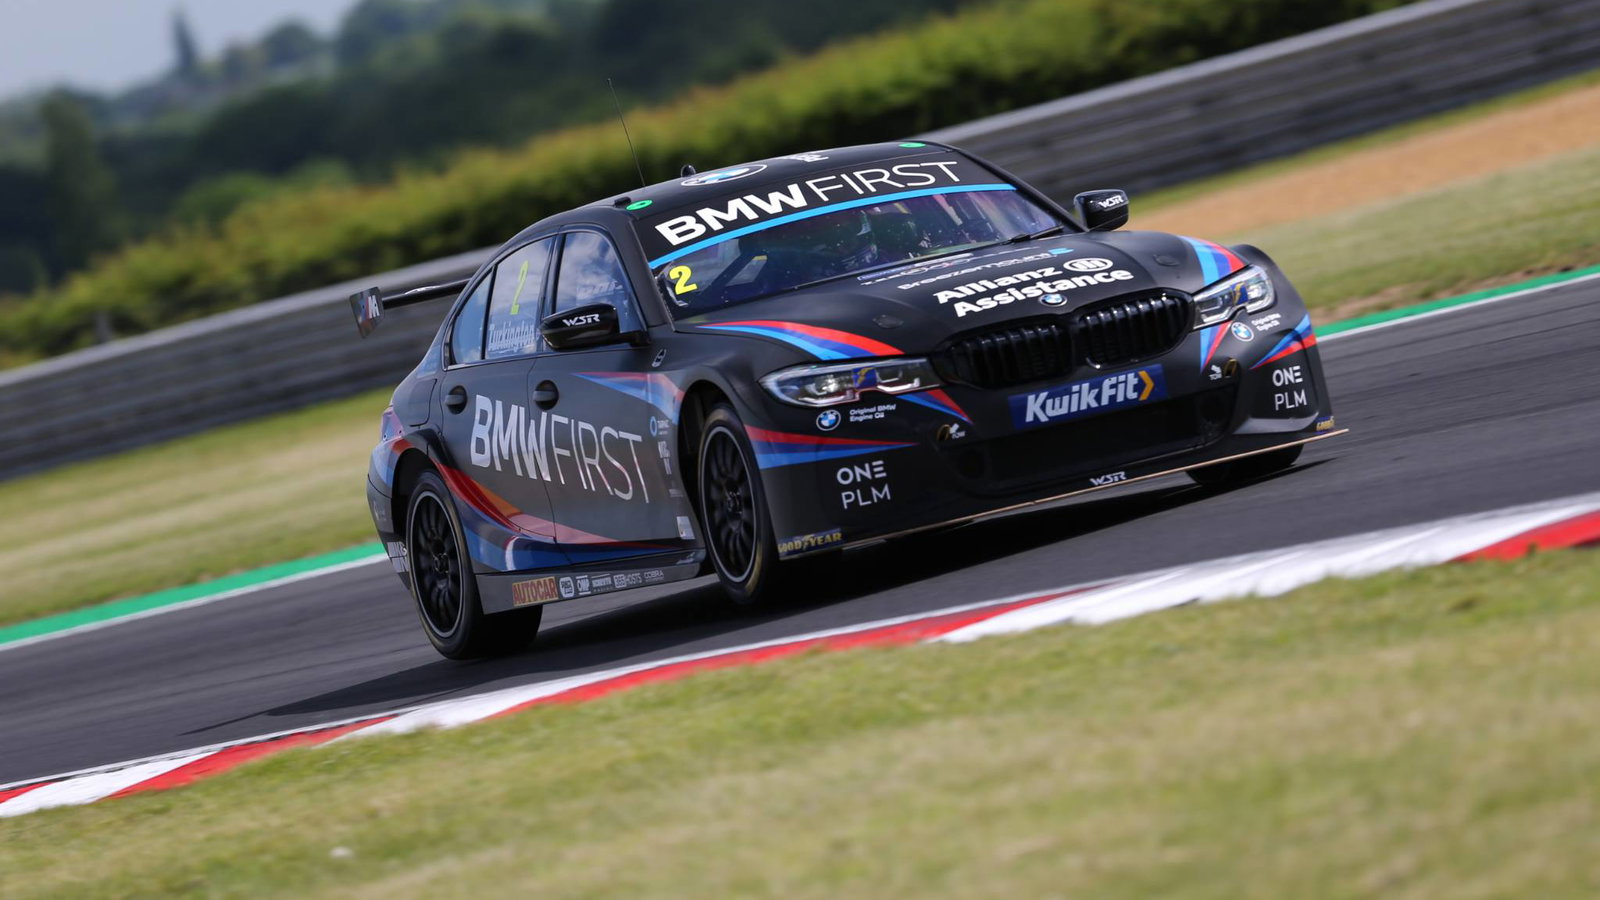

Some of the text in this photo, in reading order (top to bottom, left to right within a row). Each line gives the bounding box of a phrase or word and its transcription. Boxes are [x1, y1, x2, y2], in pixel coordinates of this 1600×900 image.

[510, 260, 529, 316] 2
[669, 265, 698, 296] 2
[933, 266, 1064, 304] Allianz
[953, 269, 1134, 318] Assistance
[562, 313, 600, 327] WSR
[1272, 365, 1303, 387] ONE
[849, 404, 897, 416] Original BMW
[1274, 389, 1308, 411] PLM
[849, 414, 873, 422] Engine
[836, 460, 887, 485] ONE
[1090, 471, 1127, 487] WSR
[841, 483, 891, 510] PLM
[512, 578, 558, 605] AUTOCAR
